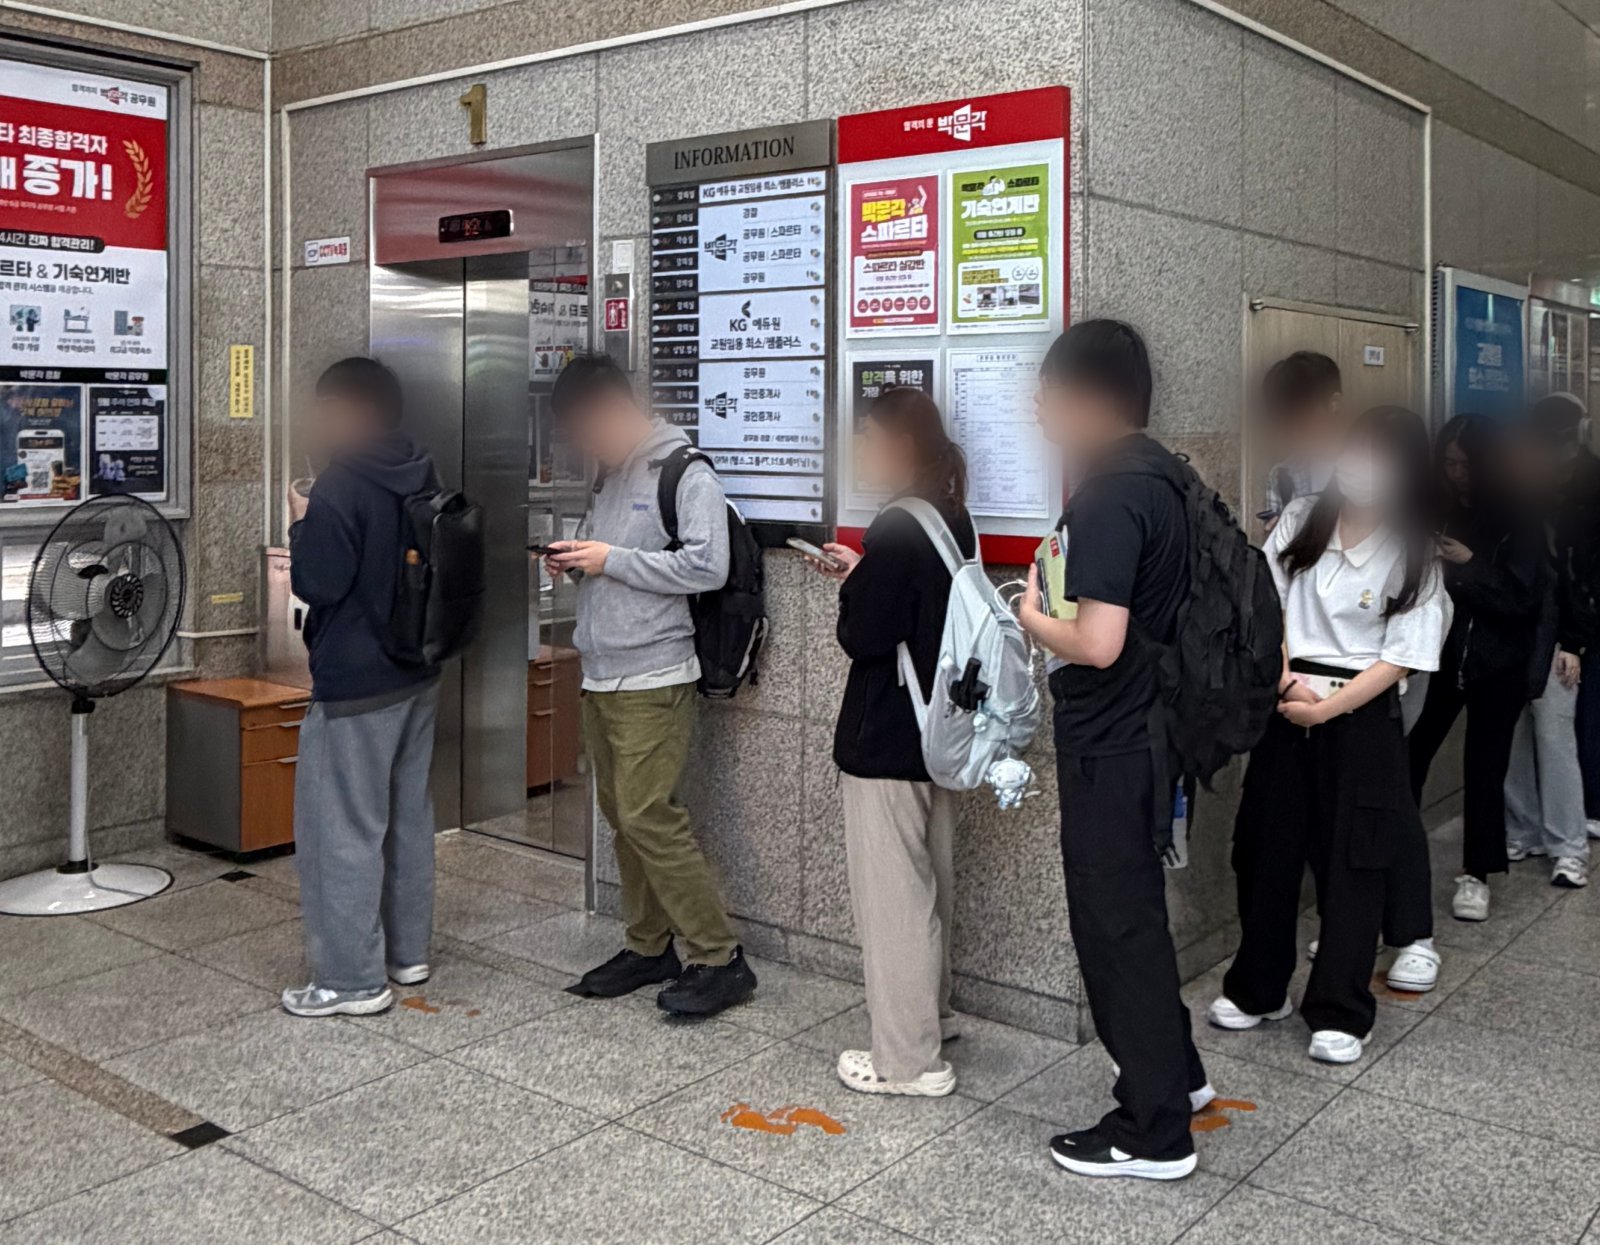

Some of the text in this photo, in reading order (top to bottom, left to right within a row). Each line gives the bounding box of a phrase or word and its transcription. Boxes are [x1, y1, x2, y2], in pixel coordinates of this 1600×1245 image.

[459, 84, 487, 145] 1
[938, 104, 988, 142] 박문각
[18, 125, 108, 155] 최종합격자
[674, 136, 795, 170] INFORMATION
[23, 153, 113, 200] 증가!
[861, 198, 906, 223] 박문각
[743, 225, 801, 240] 공무원 스파르타
[861, 214, 928, 243] 스파르타
[743, 248, 801, 262] 공무원 스파르타
[36, 264, 48, 279] &
[53, 264, 131, 285] 기숙연계반
[729, 317, 781, 332] KG 에듀원
[862, 369, 923, 385] 합격을 위한
[704, 391, 738, 419] 박문각
[744, 411, 780, 422] 공인중개사
